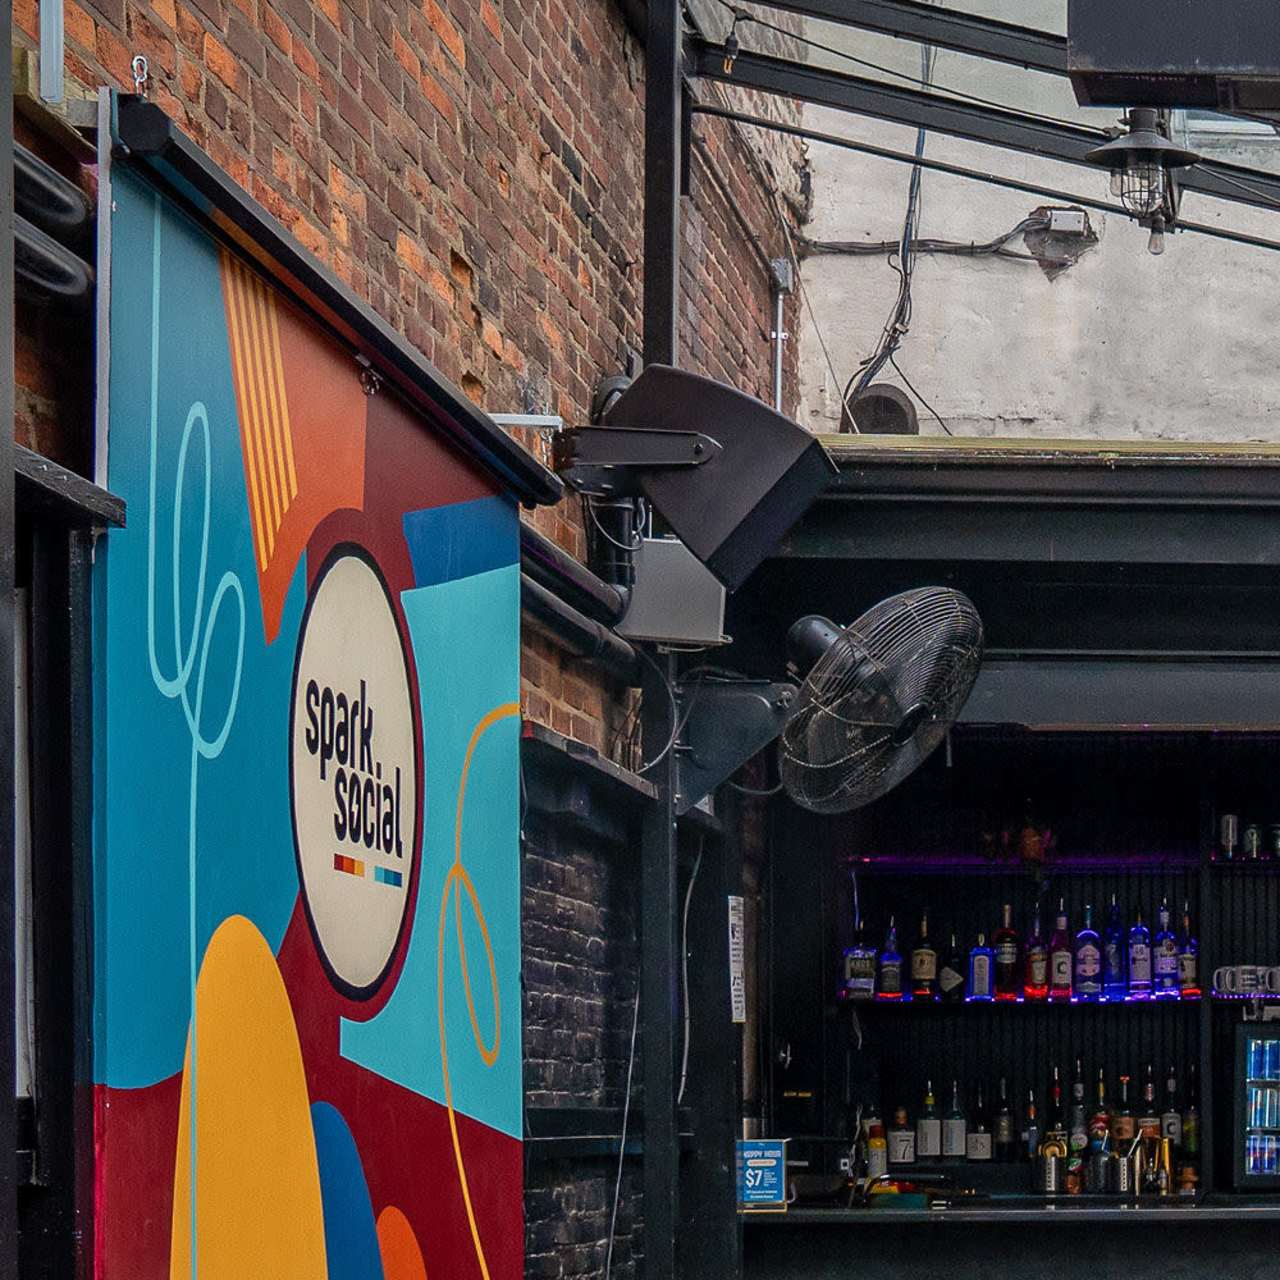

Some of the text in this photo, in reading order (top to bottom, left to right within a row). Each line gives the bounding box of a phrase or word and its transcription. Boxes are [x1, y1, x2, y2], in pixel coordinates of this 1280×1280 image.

[305, 679, 374, 781] spark
[334, 762, 403, 859] social
[746, 1168, 763, 1188] $7
